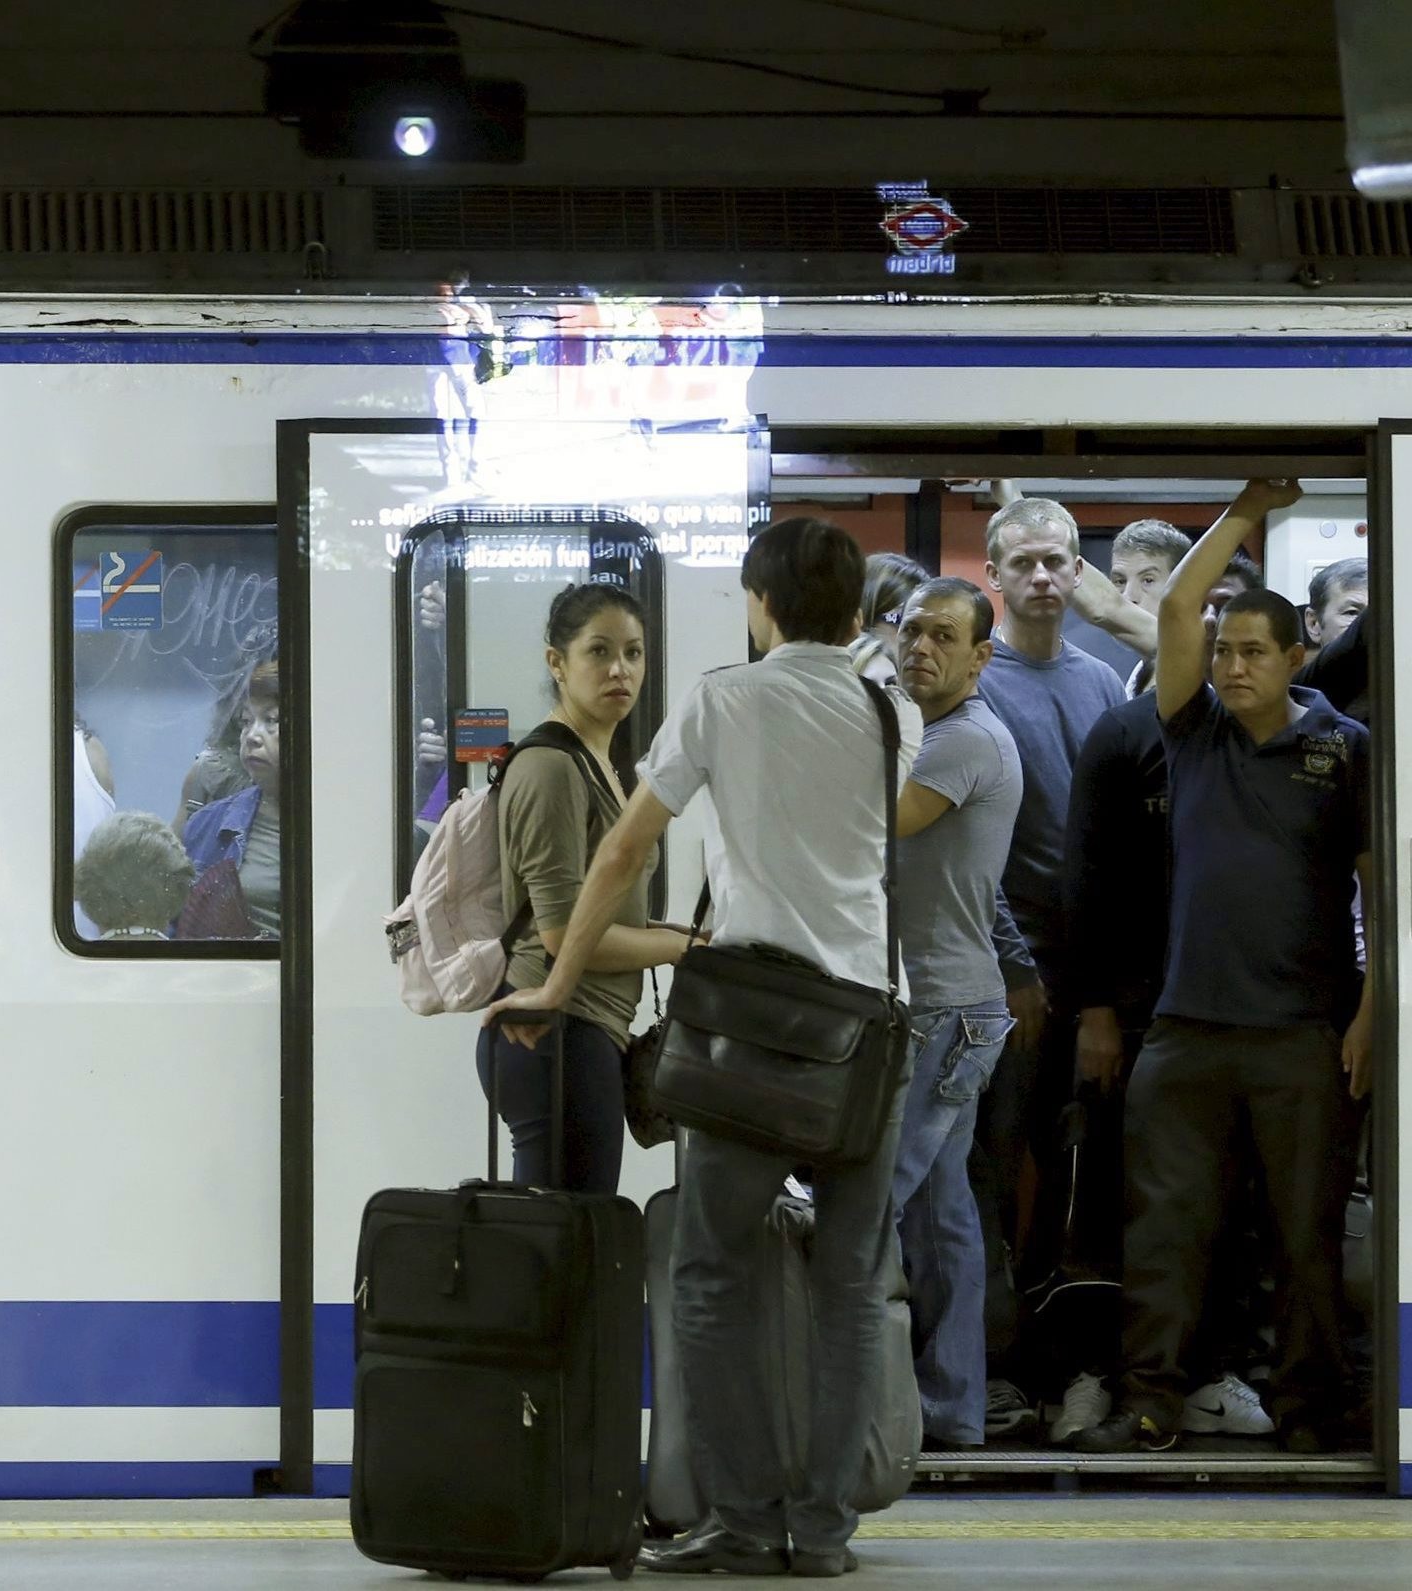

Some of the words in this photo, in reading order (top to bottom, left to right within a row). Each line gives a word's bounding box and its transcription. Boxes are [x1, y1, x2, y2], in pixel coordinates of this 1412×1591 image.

[887, 254, 955, 274] madrid
[462, 503, 545, 522] también
[550, 509, 576, 522] en
[581, 501, 600, 522] el
[664, 506, 702, 528] que
[705, 505, 743, 524] van
[691, 532, 756, 560] porqu
